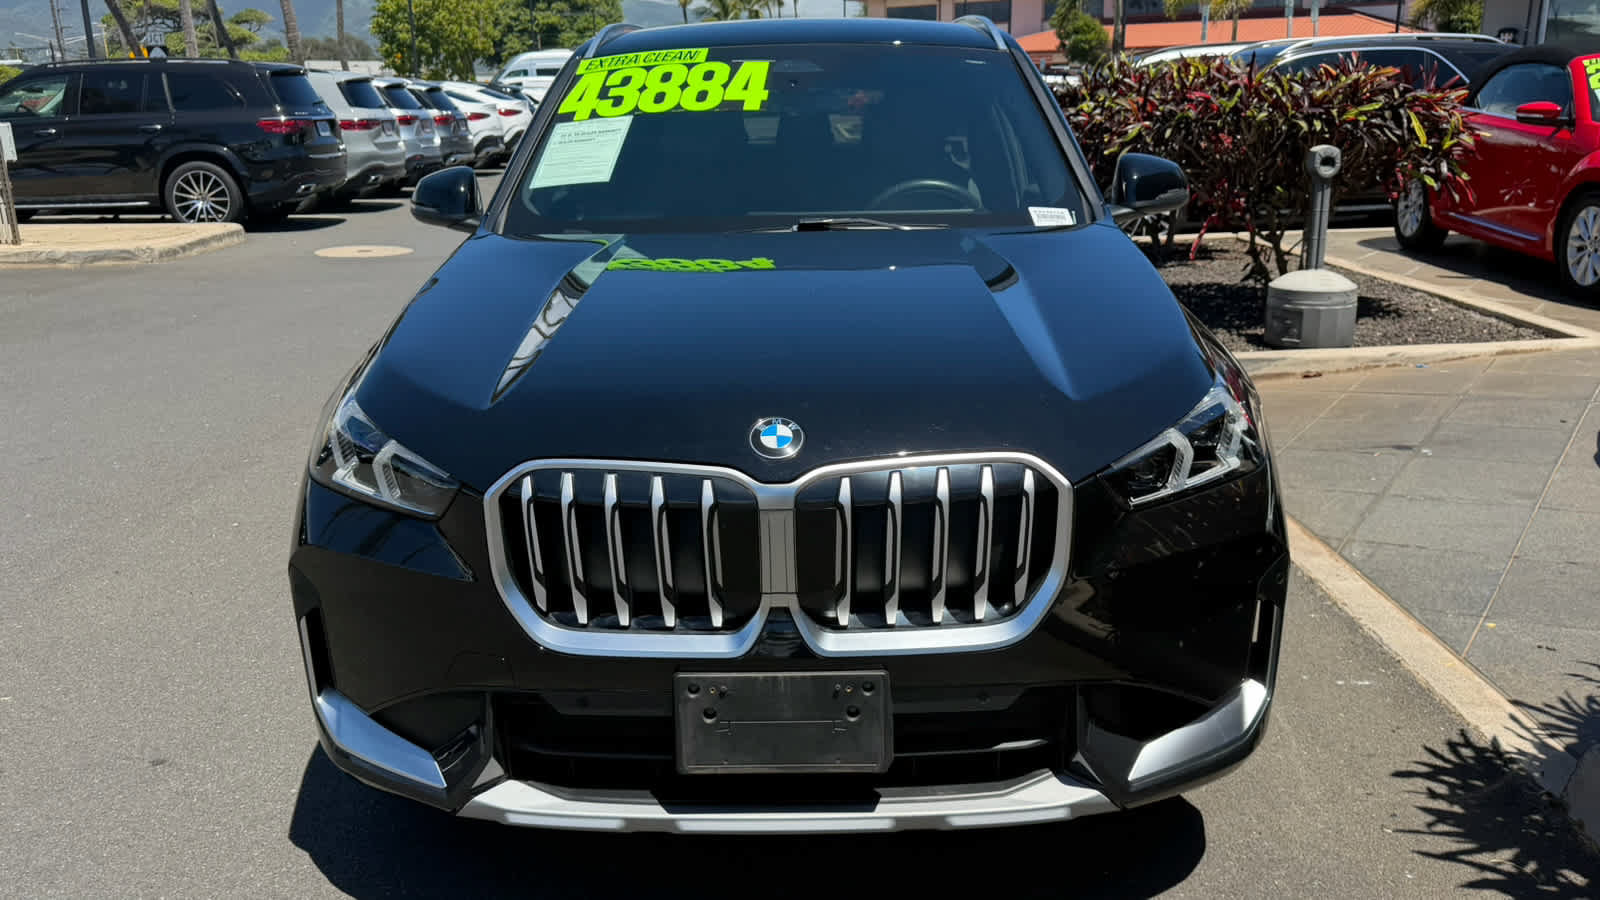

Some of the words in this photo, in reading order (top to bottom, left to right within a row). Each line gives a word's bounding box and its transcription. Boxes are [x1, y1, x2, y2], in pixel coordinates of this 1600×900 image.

[585, 54, 641, 70] EXTRA
[643, 50, 701, 63] CLEAN
[558, 60, 770, 121] 43884
